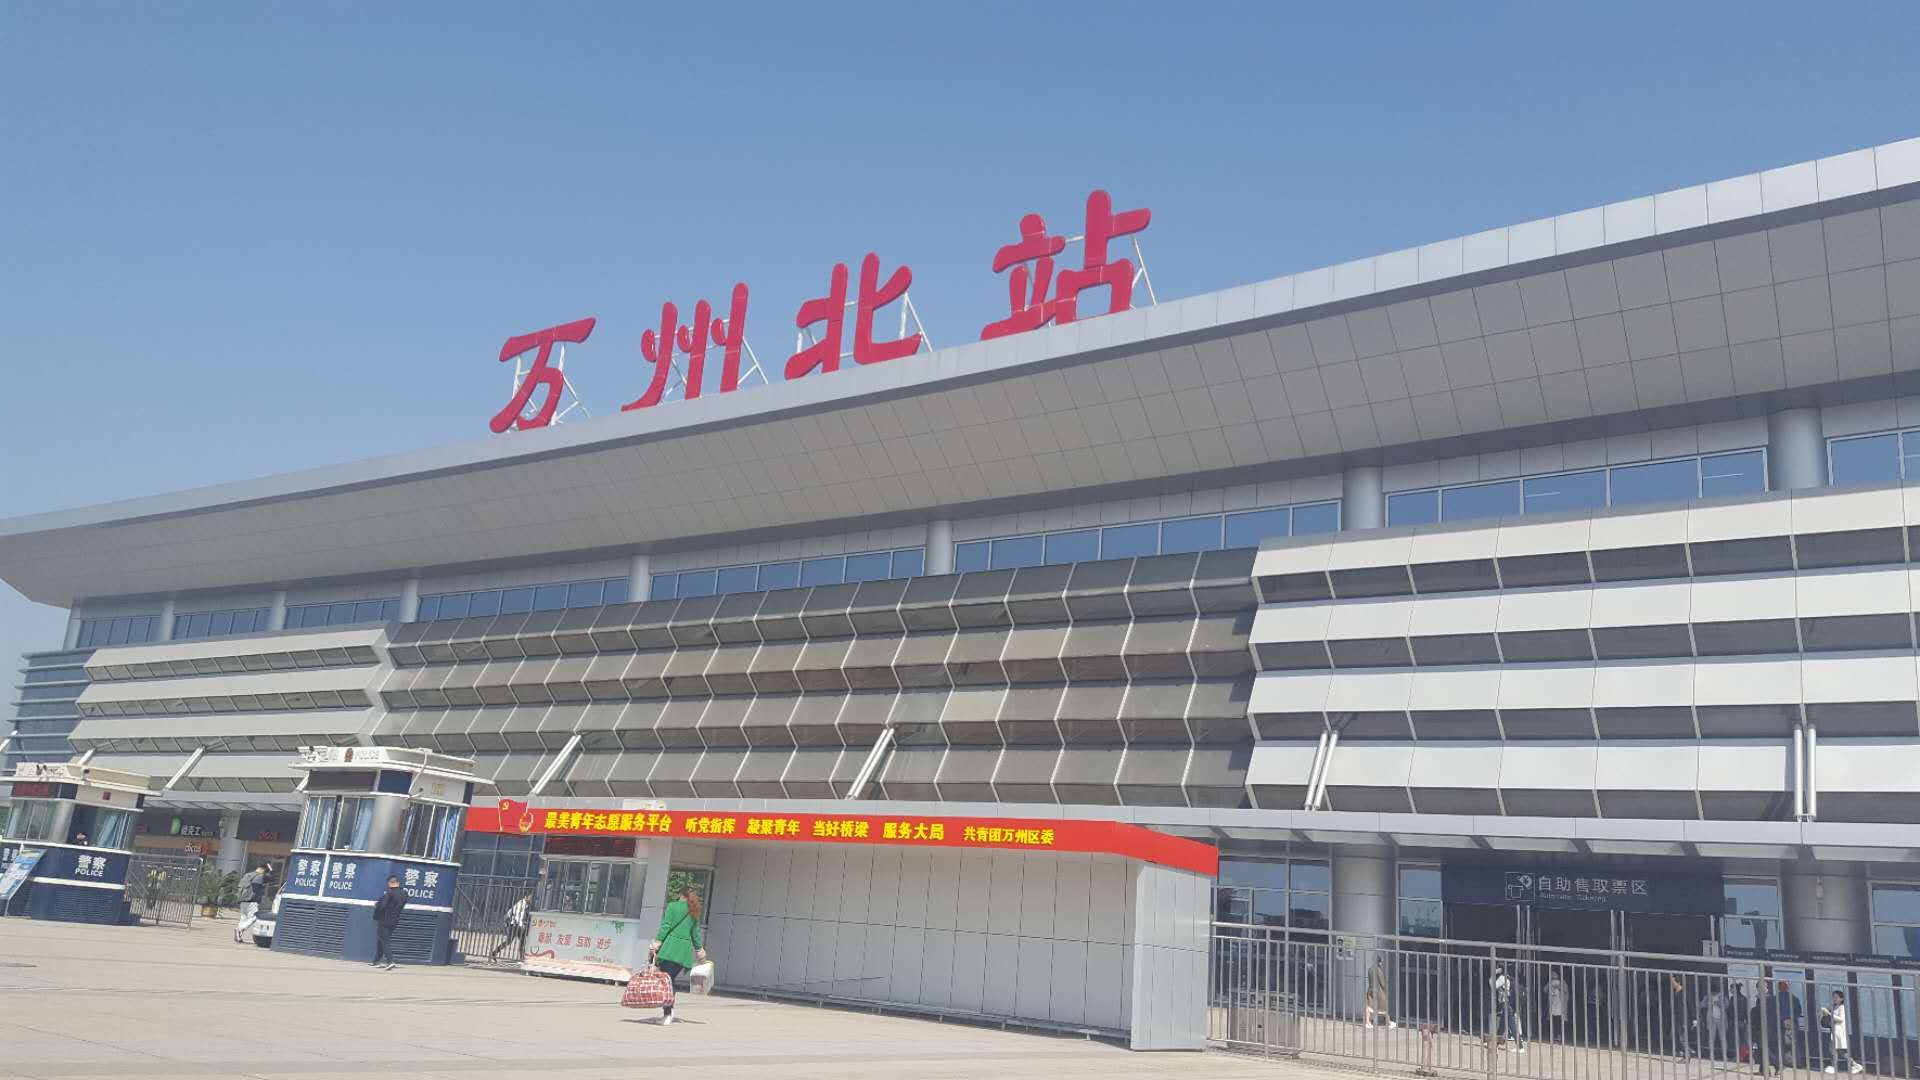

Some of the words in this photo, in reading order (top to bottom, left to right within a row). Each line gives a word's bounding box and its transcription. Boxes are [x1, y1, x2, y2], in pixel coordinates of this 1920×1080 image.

[490, 189, 1151, 433] 万州北站
[544, 811, 672, 833] 最美青年志愿服务平台
[685, 817, 736, 834] 听党指挥
[747, 818, 800, 836] 凝聚青年
[813, 820, 869, 838] 当好桥梁
[883, 822, 944, 840] 服务大局
[963, 827, 1054, 844] 共青团万州区委
[78, 854, 107, 870] 警察
[297, 859, 322, 877] 警察
[331, 862, 357, 879] 警察
[75, 867, 104, 877] POLICE
[404, 868, 439, 888] 警察
[295, 877, 317, 888] POLICE
[329, 880, 353, 891] POLICE
[1538, 876, 1648, 895] 自助售取票区
